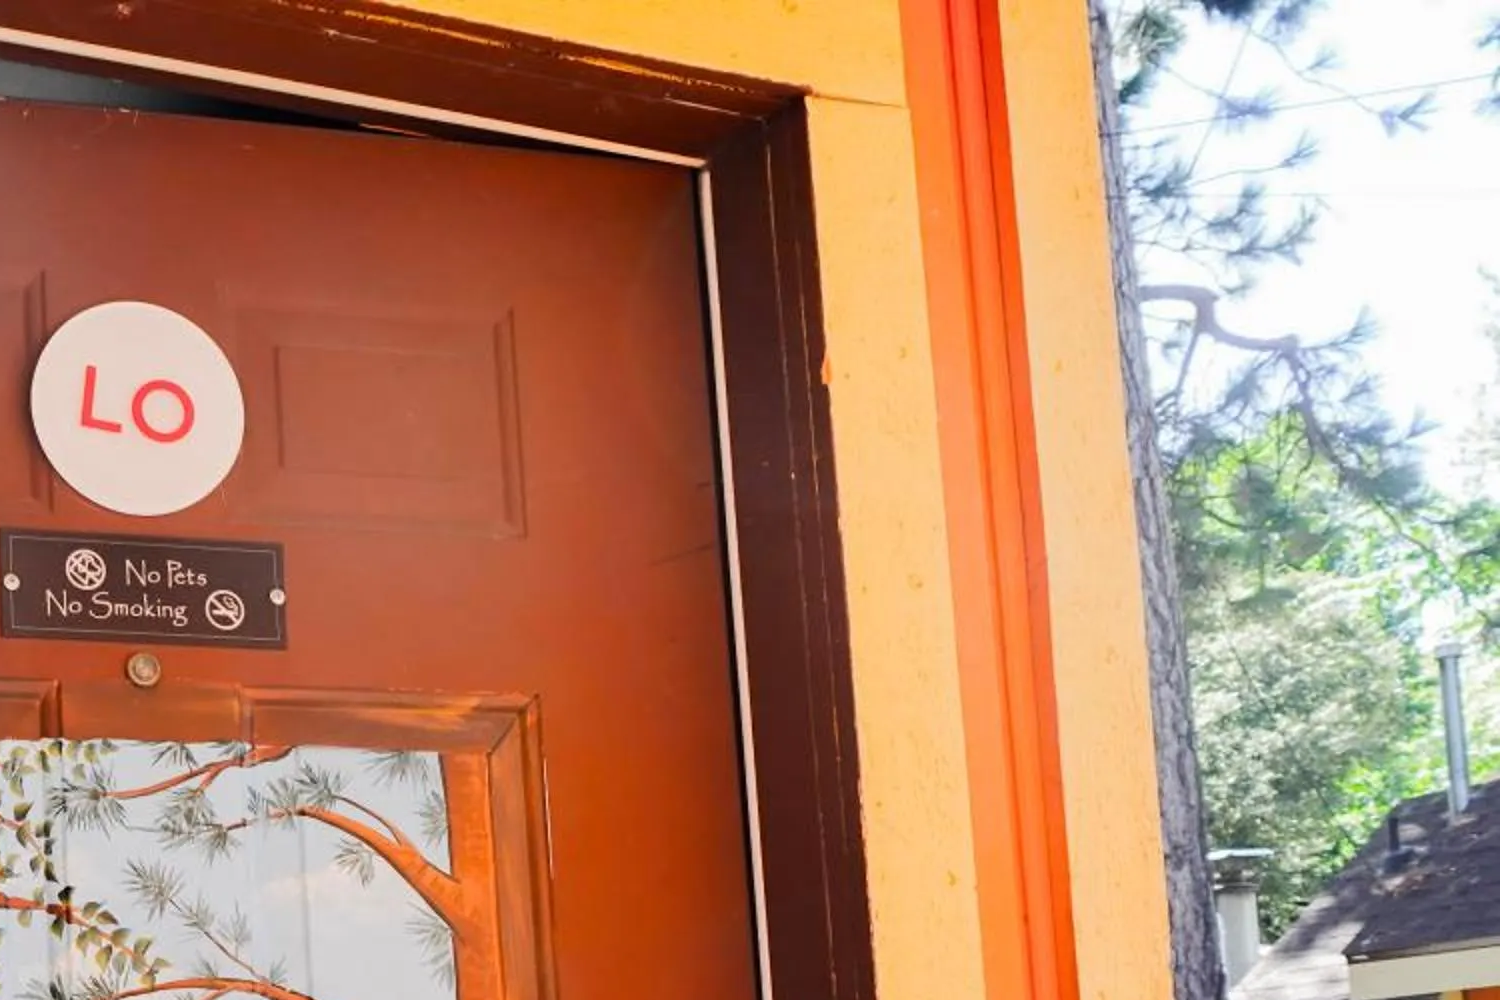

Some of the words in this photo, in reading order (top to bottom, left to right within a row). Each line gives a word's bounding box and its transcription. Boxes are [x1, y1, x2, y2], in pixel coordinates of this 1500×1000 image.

[80, 365, 195, 443] LO
[124, 559, 161, 587] No
[166, 559, 208, 589] Pets
[45, 588, 83, 618] No
[89, 591, 189, 627] Smoking
